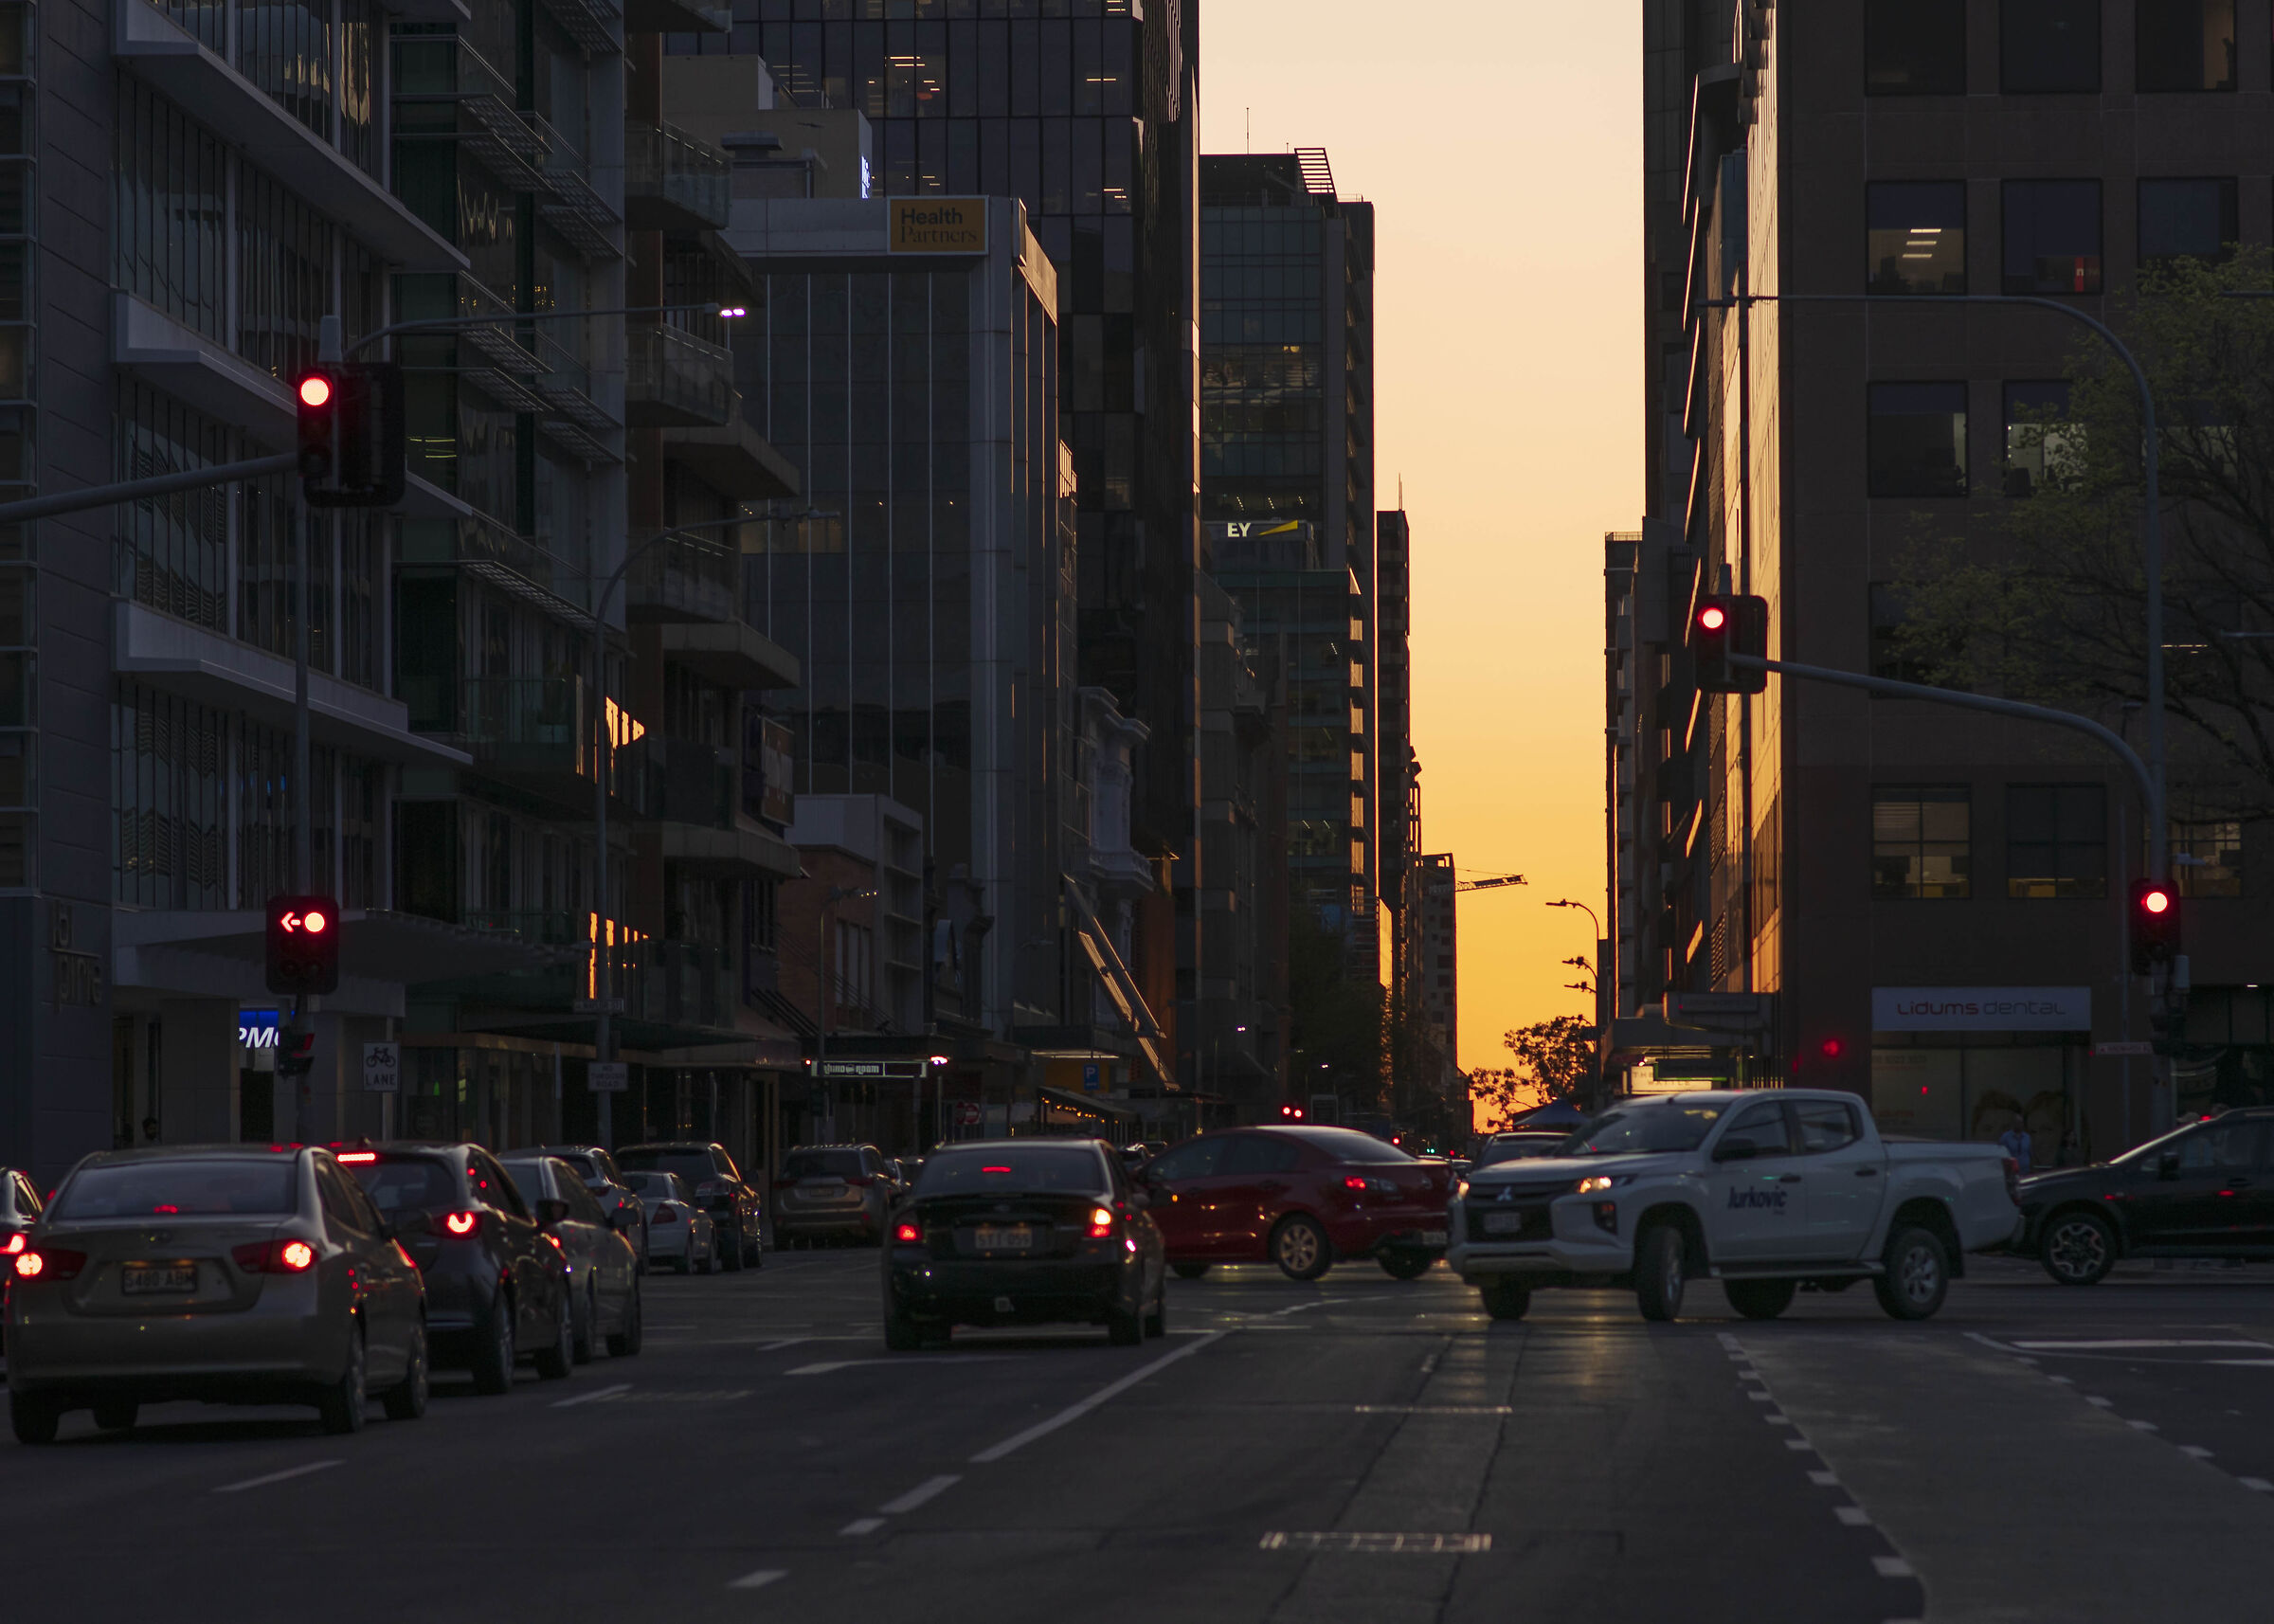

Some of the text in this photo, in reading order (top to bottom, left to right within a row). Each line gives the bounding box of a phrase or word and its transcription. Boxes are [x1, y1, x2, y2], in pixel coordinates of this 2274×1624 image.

[901, 207, 963, 225] Health
[901, 226, 978, 244] Partners
[1227, 522, 1252, 538] EY
[1897, 1000, 2066, 1016] Lidums dental
[239, 1026, 280, 1049] PM
[366, 1074, 395, 1085] LANE
